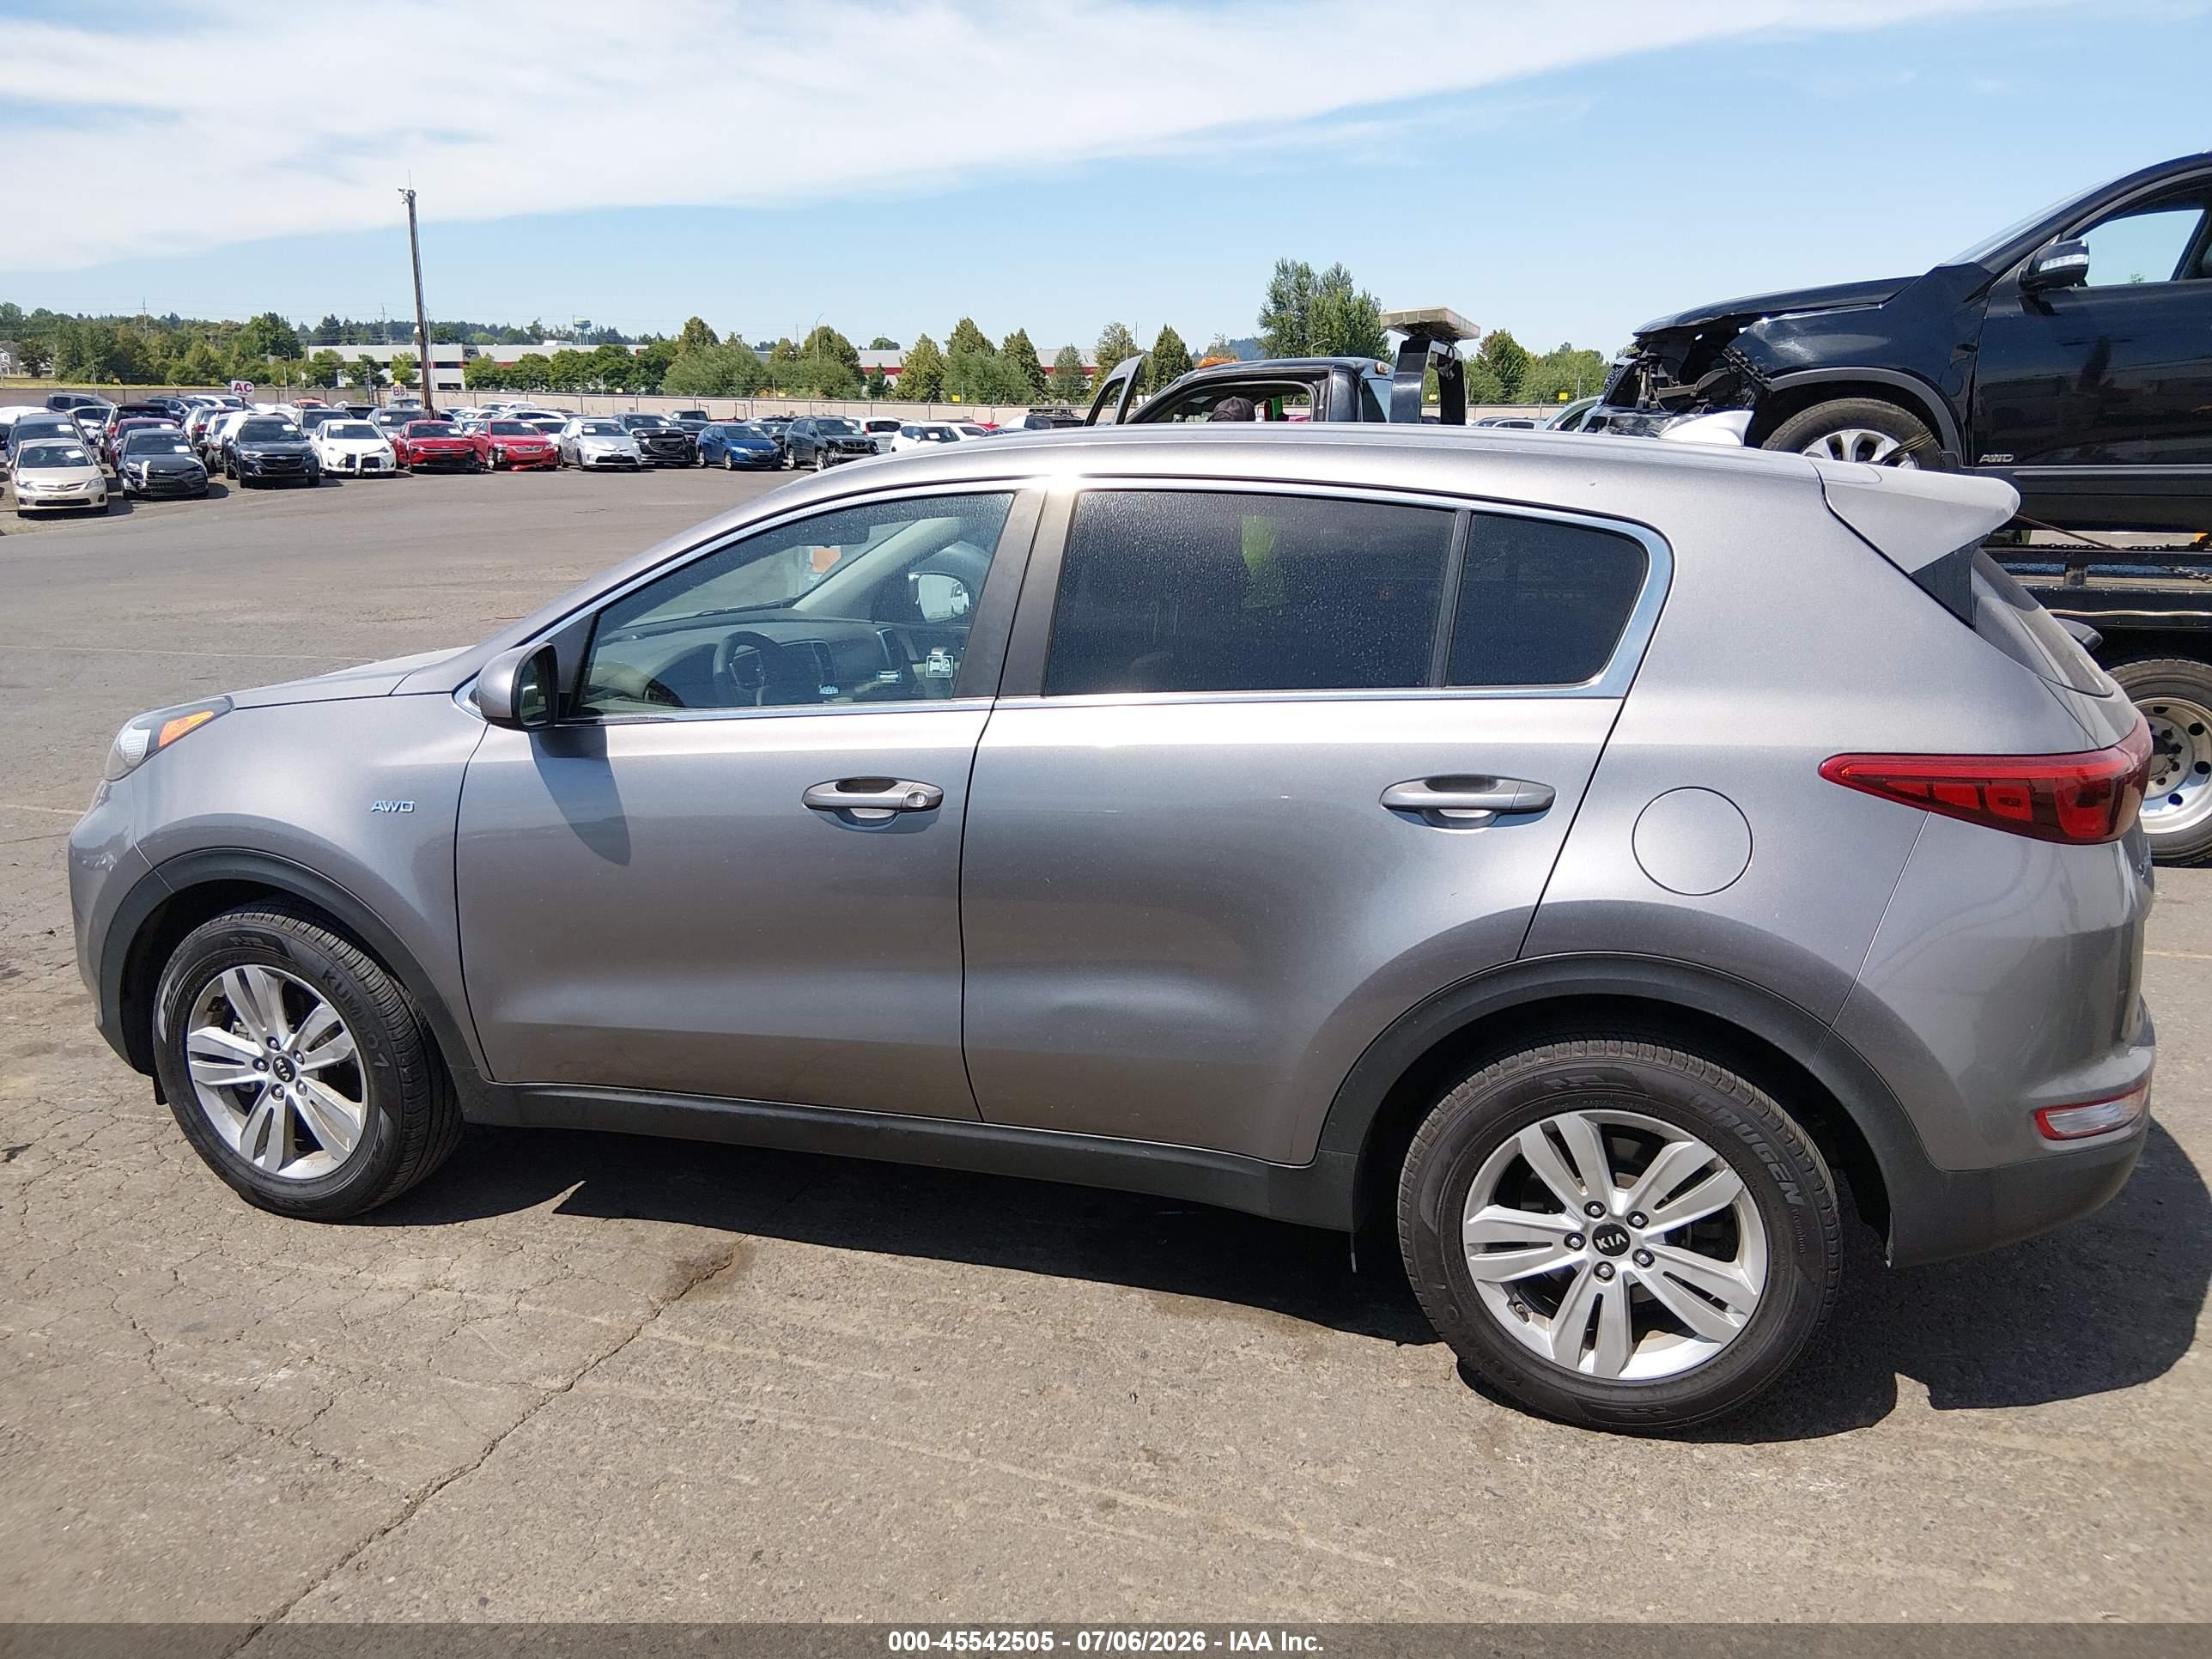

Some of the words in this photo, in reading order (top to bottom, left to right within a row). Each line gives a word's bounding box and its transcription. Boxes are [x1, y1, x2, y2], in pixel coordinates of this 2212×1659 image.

[234, 382, 253, 392] AC
[392, 386, 406, 396] BB
[1978, 453, 2014, 464] AWD
[370, 799, 416, 813] AWD
[321, 969, 379, 1050] KUMO
[275, 1058, 291, 1081] KIA
[1688, 1093, 1807, 1205] CRUGEN
[1595, 1232, 1627, 1250] KIA
